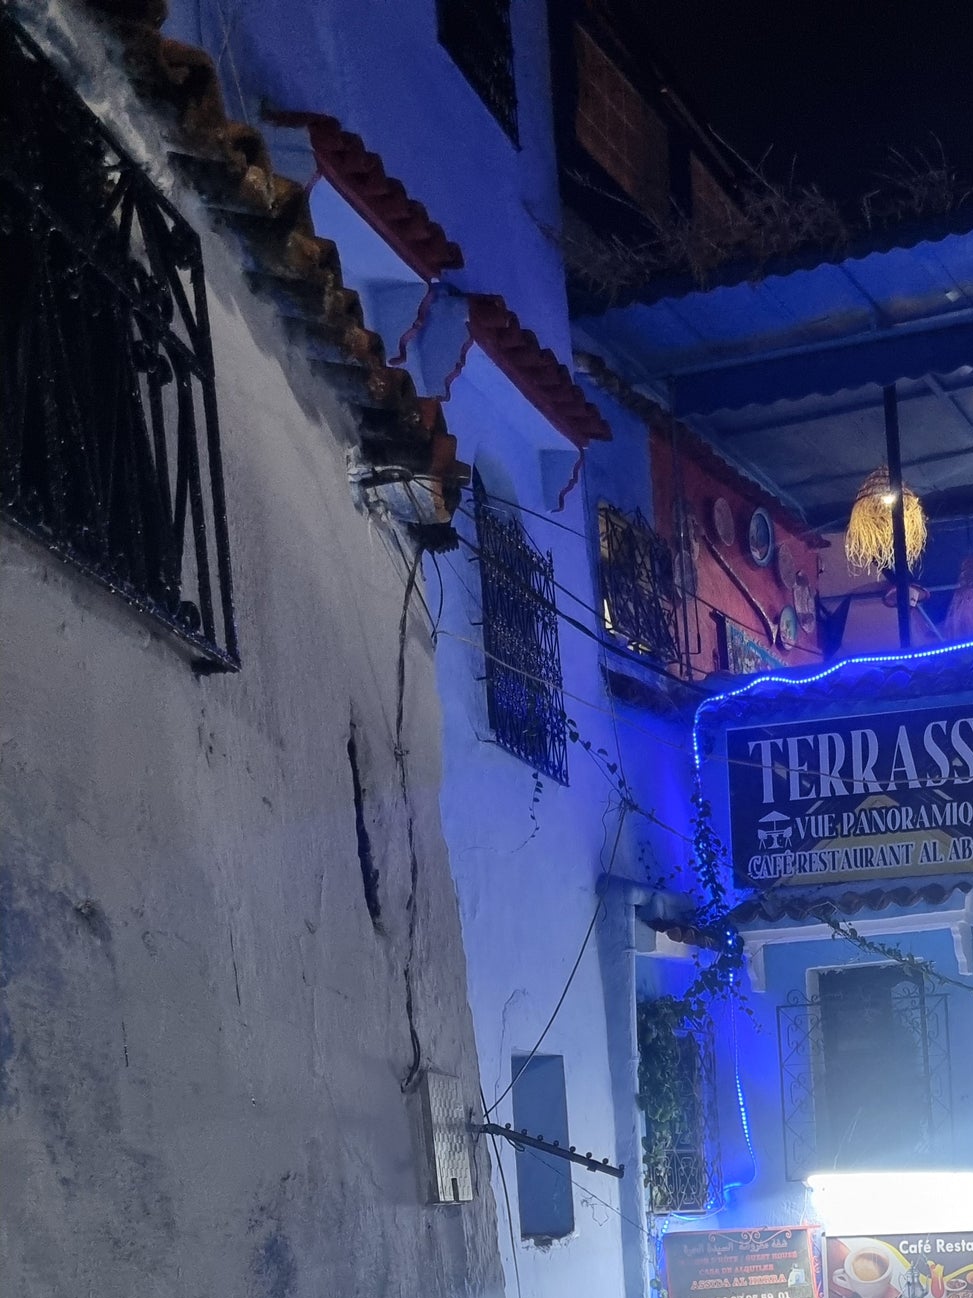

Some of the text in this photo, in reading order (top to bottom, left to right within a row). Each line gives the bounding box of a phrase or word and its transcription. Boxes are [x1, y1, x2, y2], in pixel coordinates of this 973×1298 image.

[795, 814, 837, 839] VUE
[798, 843, 914, 875] RESTAURANT
[919, 844, 944, 864] AL
[899, 1237, 931, 1254] Café
[732, 1277, 748, 1287] AL
